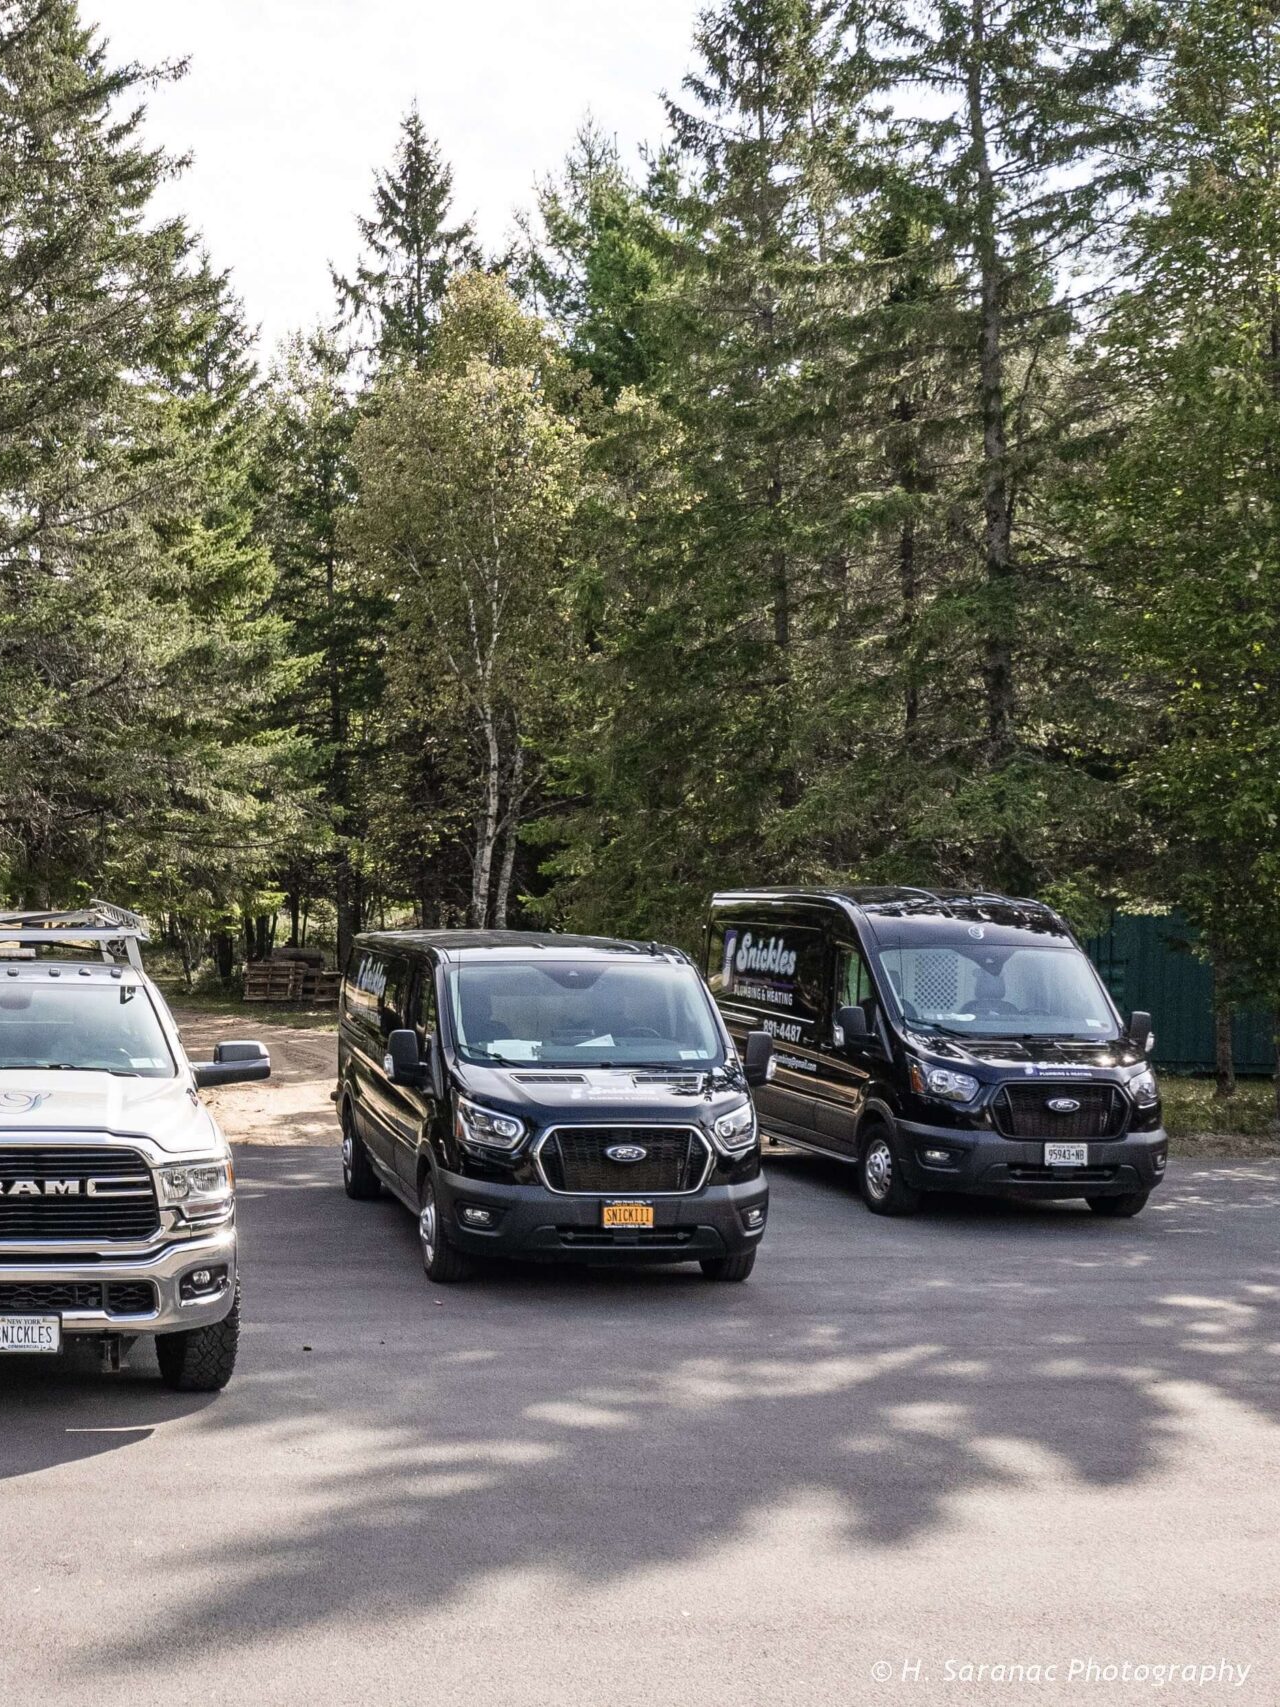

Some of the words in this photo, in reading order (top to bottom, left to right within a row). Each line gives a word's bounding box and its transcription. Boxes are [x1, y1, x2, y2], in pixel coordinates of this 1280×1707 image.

[736, 932, 797, 976] Snickles
[733, 984, 761, 1000] PLUMBING
[766, 990, 793, 1006] HEATING
[763, 1019, 803, 1043] 891-4487
[606, 1208, 650, 1222] SNICKIII
